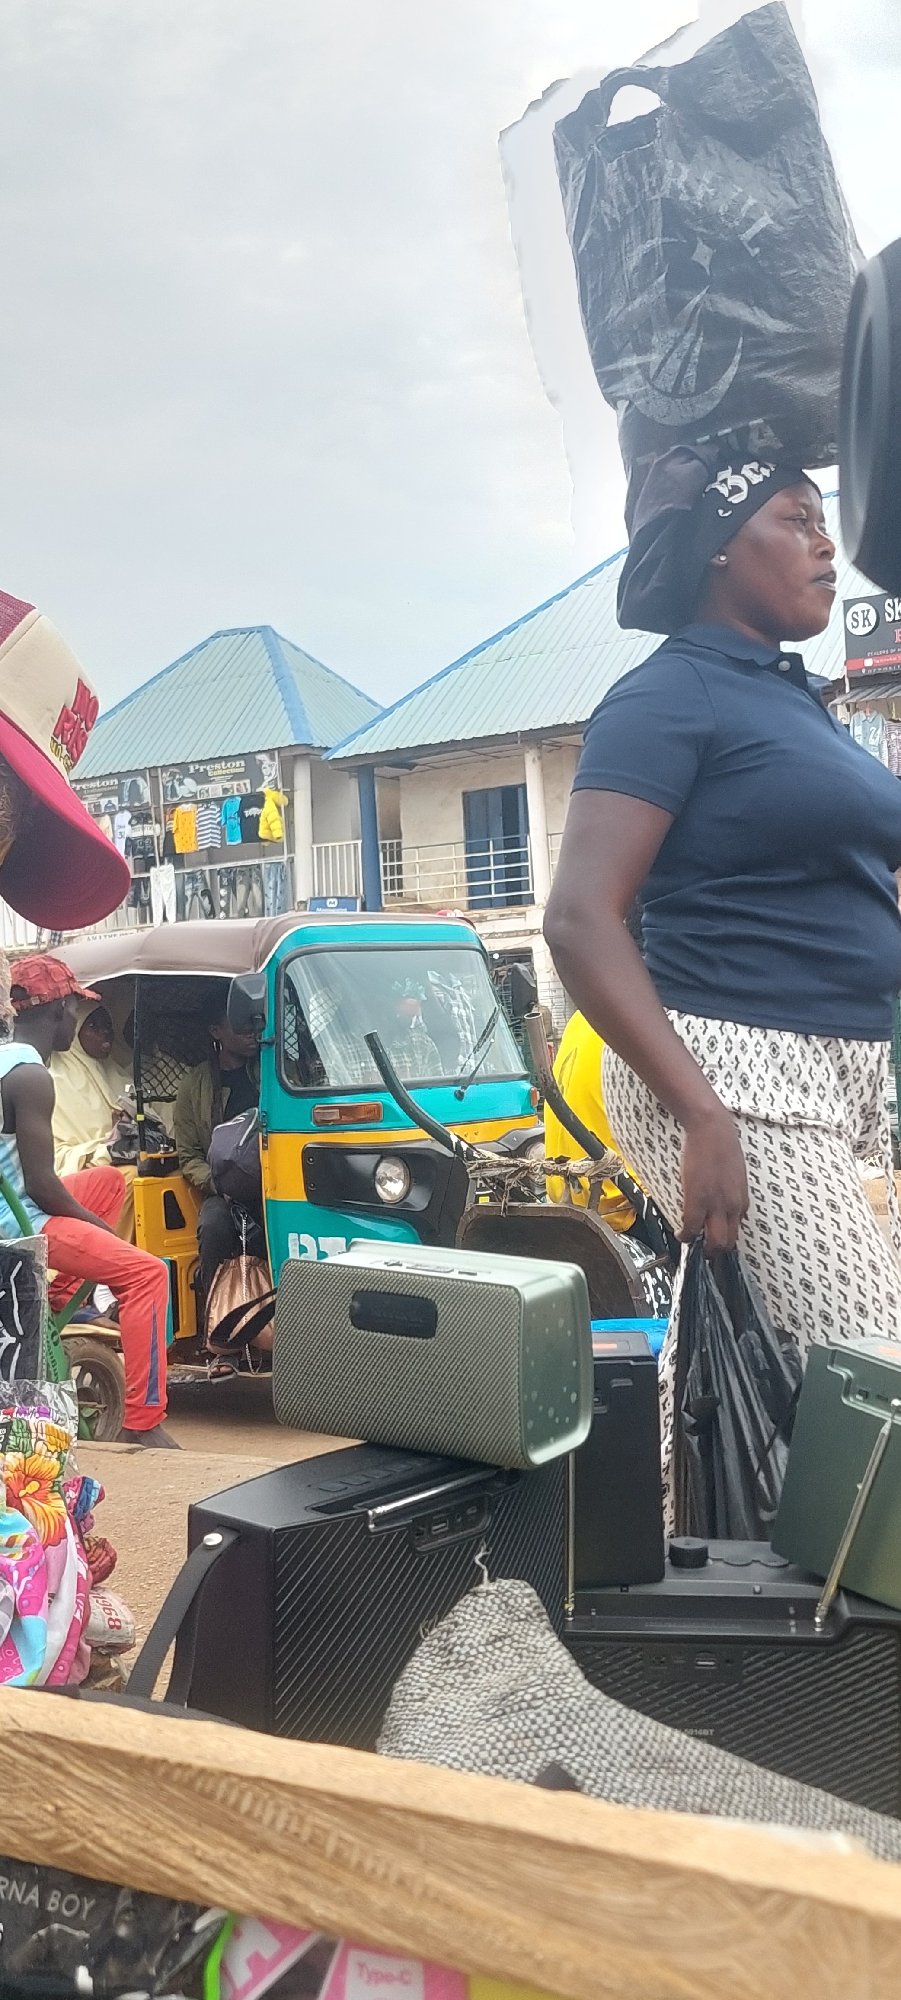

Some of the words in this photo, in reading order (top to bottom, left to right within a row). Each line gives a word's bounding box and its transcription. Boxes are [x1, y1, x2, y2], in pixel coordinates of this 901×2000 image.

[851, 608, 872, 629] SK
[188, 760, 246, 774] Preston
[207, 767, 246, 777] Collection
[47, 1889, 97, 1921] BOY
[356, 1960, 413, 1986] Type-C
